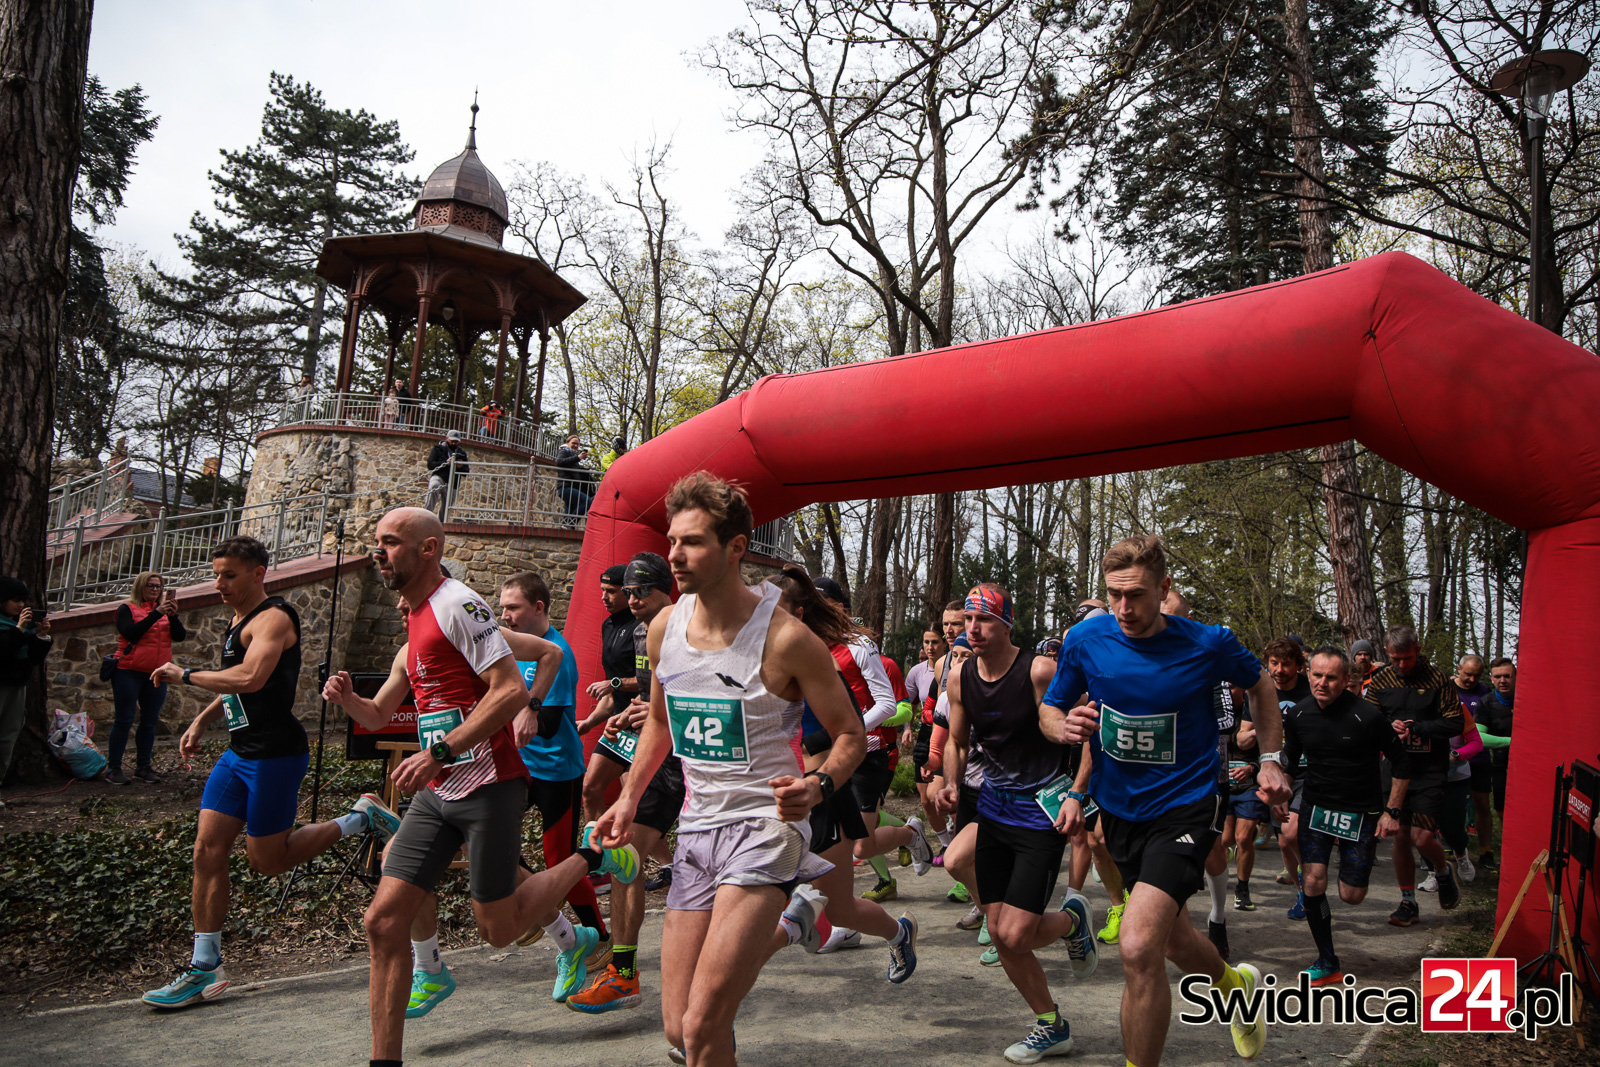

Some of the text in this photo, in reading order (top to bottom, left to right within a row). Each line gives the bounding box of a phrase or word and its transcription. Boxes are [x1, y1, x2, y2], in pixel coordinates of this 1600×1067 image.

[391, 712, 419, 722] PORT
[684, 716, 724, 746] 42
[1116, 727, 1155, 752] 55
[1405, 733, 1422, 746] 13
[1323, 809, 1352, 831] 115
